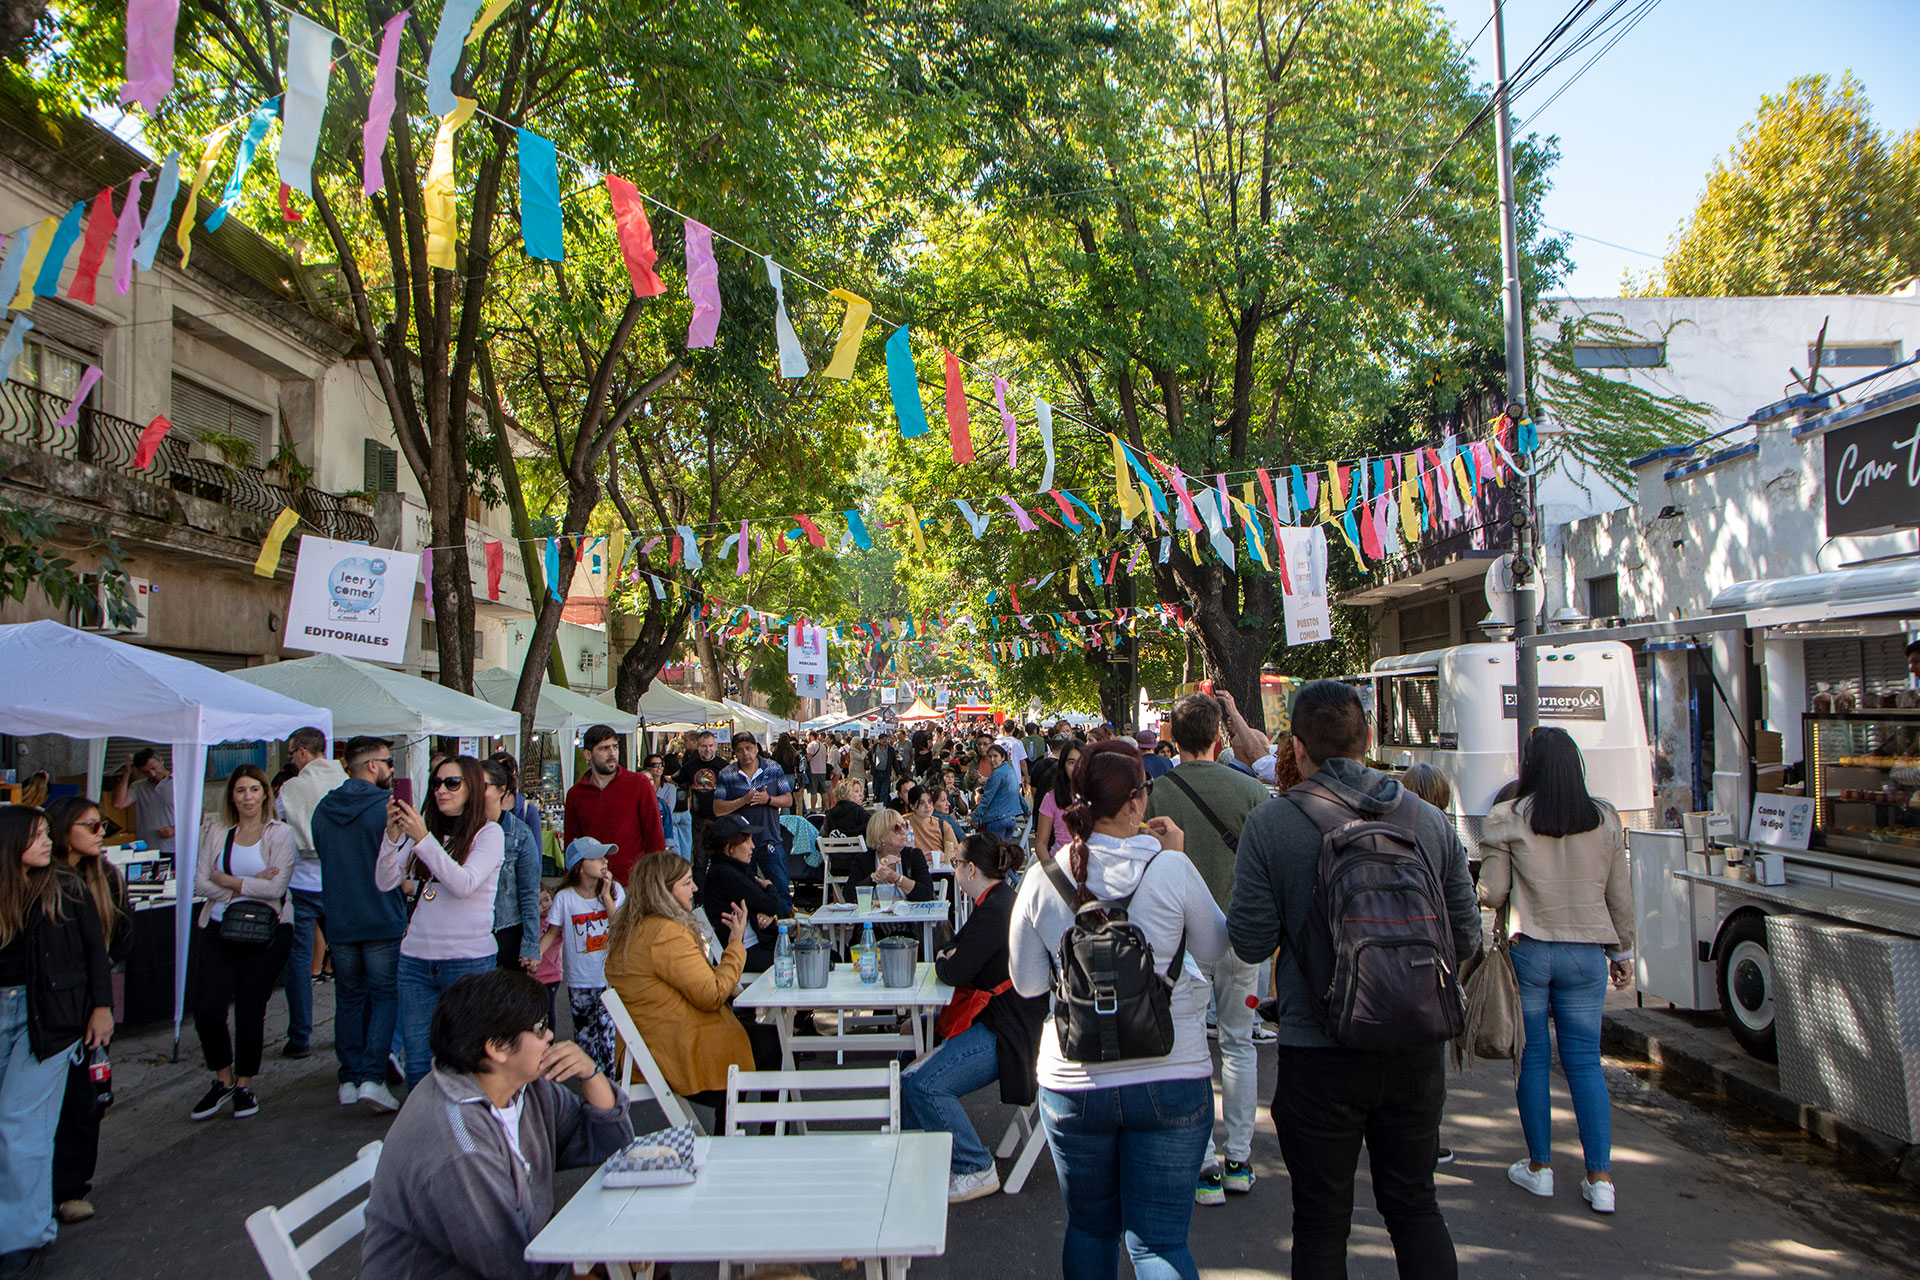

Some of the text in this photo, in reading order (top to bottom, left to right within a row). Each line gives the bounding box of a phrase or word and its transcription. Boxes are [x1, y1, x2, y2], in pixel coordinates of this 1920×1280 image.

[340, 571, 377, 589] leer y
[334, 585, 375, 599] comer
[1297, 617, 1320, 629] PUESTOS
[304, 626, 390, 646] EDITORIALES
[1299, 630, 1320, 641] COMIDA
[1504, 693, 1518, 706] El
[1758, 805, 1786, 817] Como te
[1760, 818, 1784, 830] lo digo
